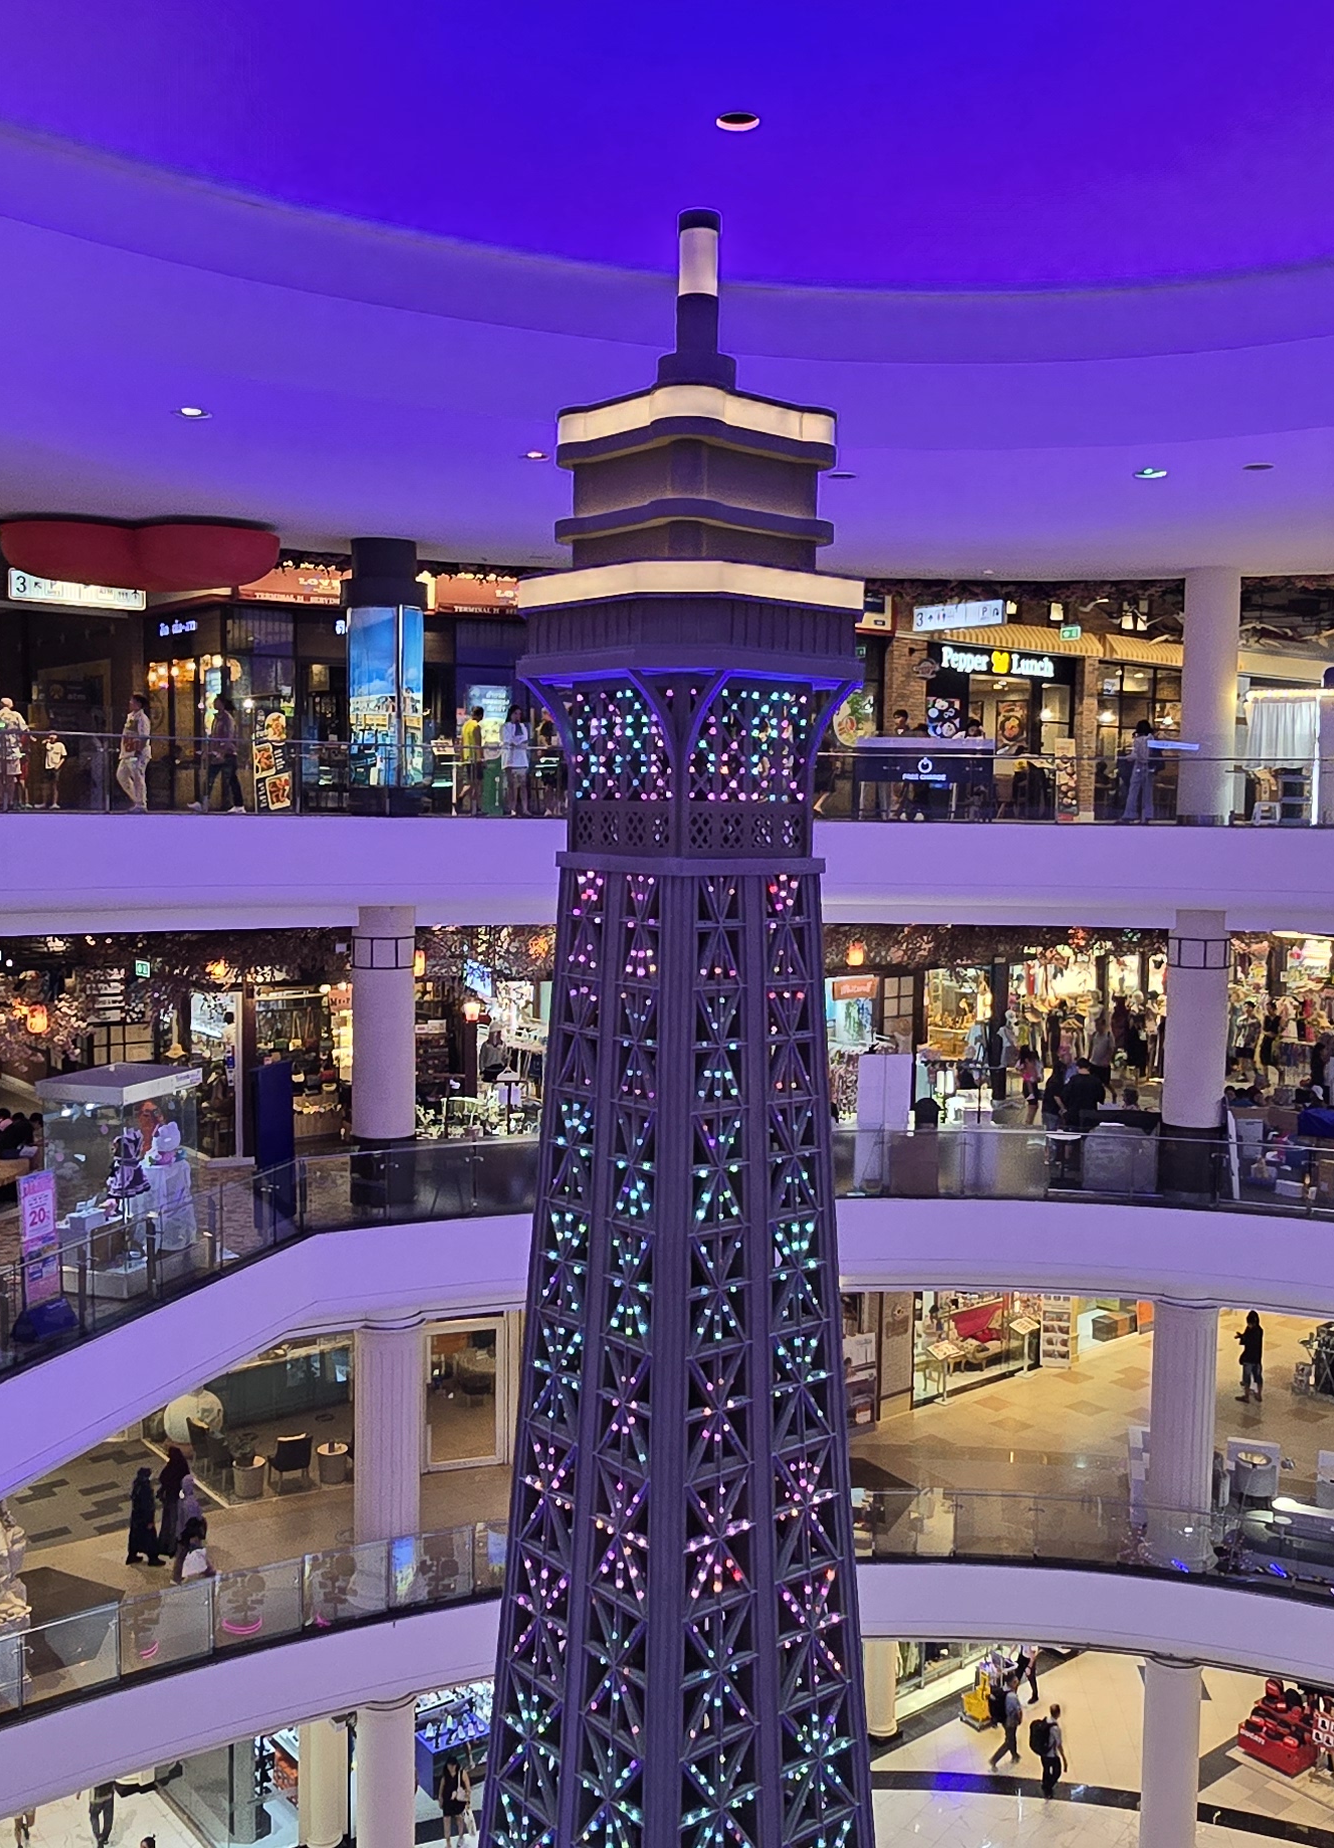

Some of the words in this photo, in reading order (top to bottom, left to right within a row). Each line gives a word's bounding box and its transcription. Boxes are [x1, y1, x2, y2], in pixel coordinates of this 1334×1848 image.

[16, 575, 27, 593] 3
[453, 605, 492, 614] TERMINAL
[916, 612, 925, 627] 3
[941, 646, 990, 673] Pepper
[1010, 653, 1055, 678] Lunch
